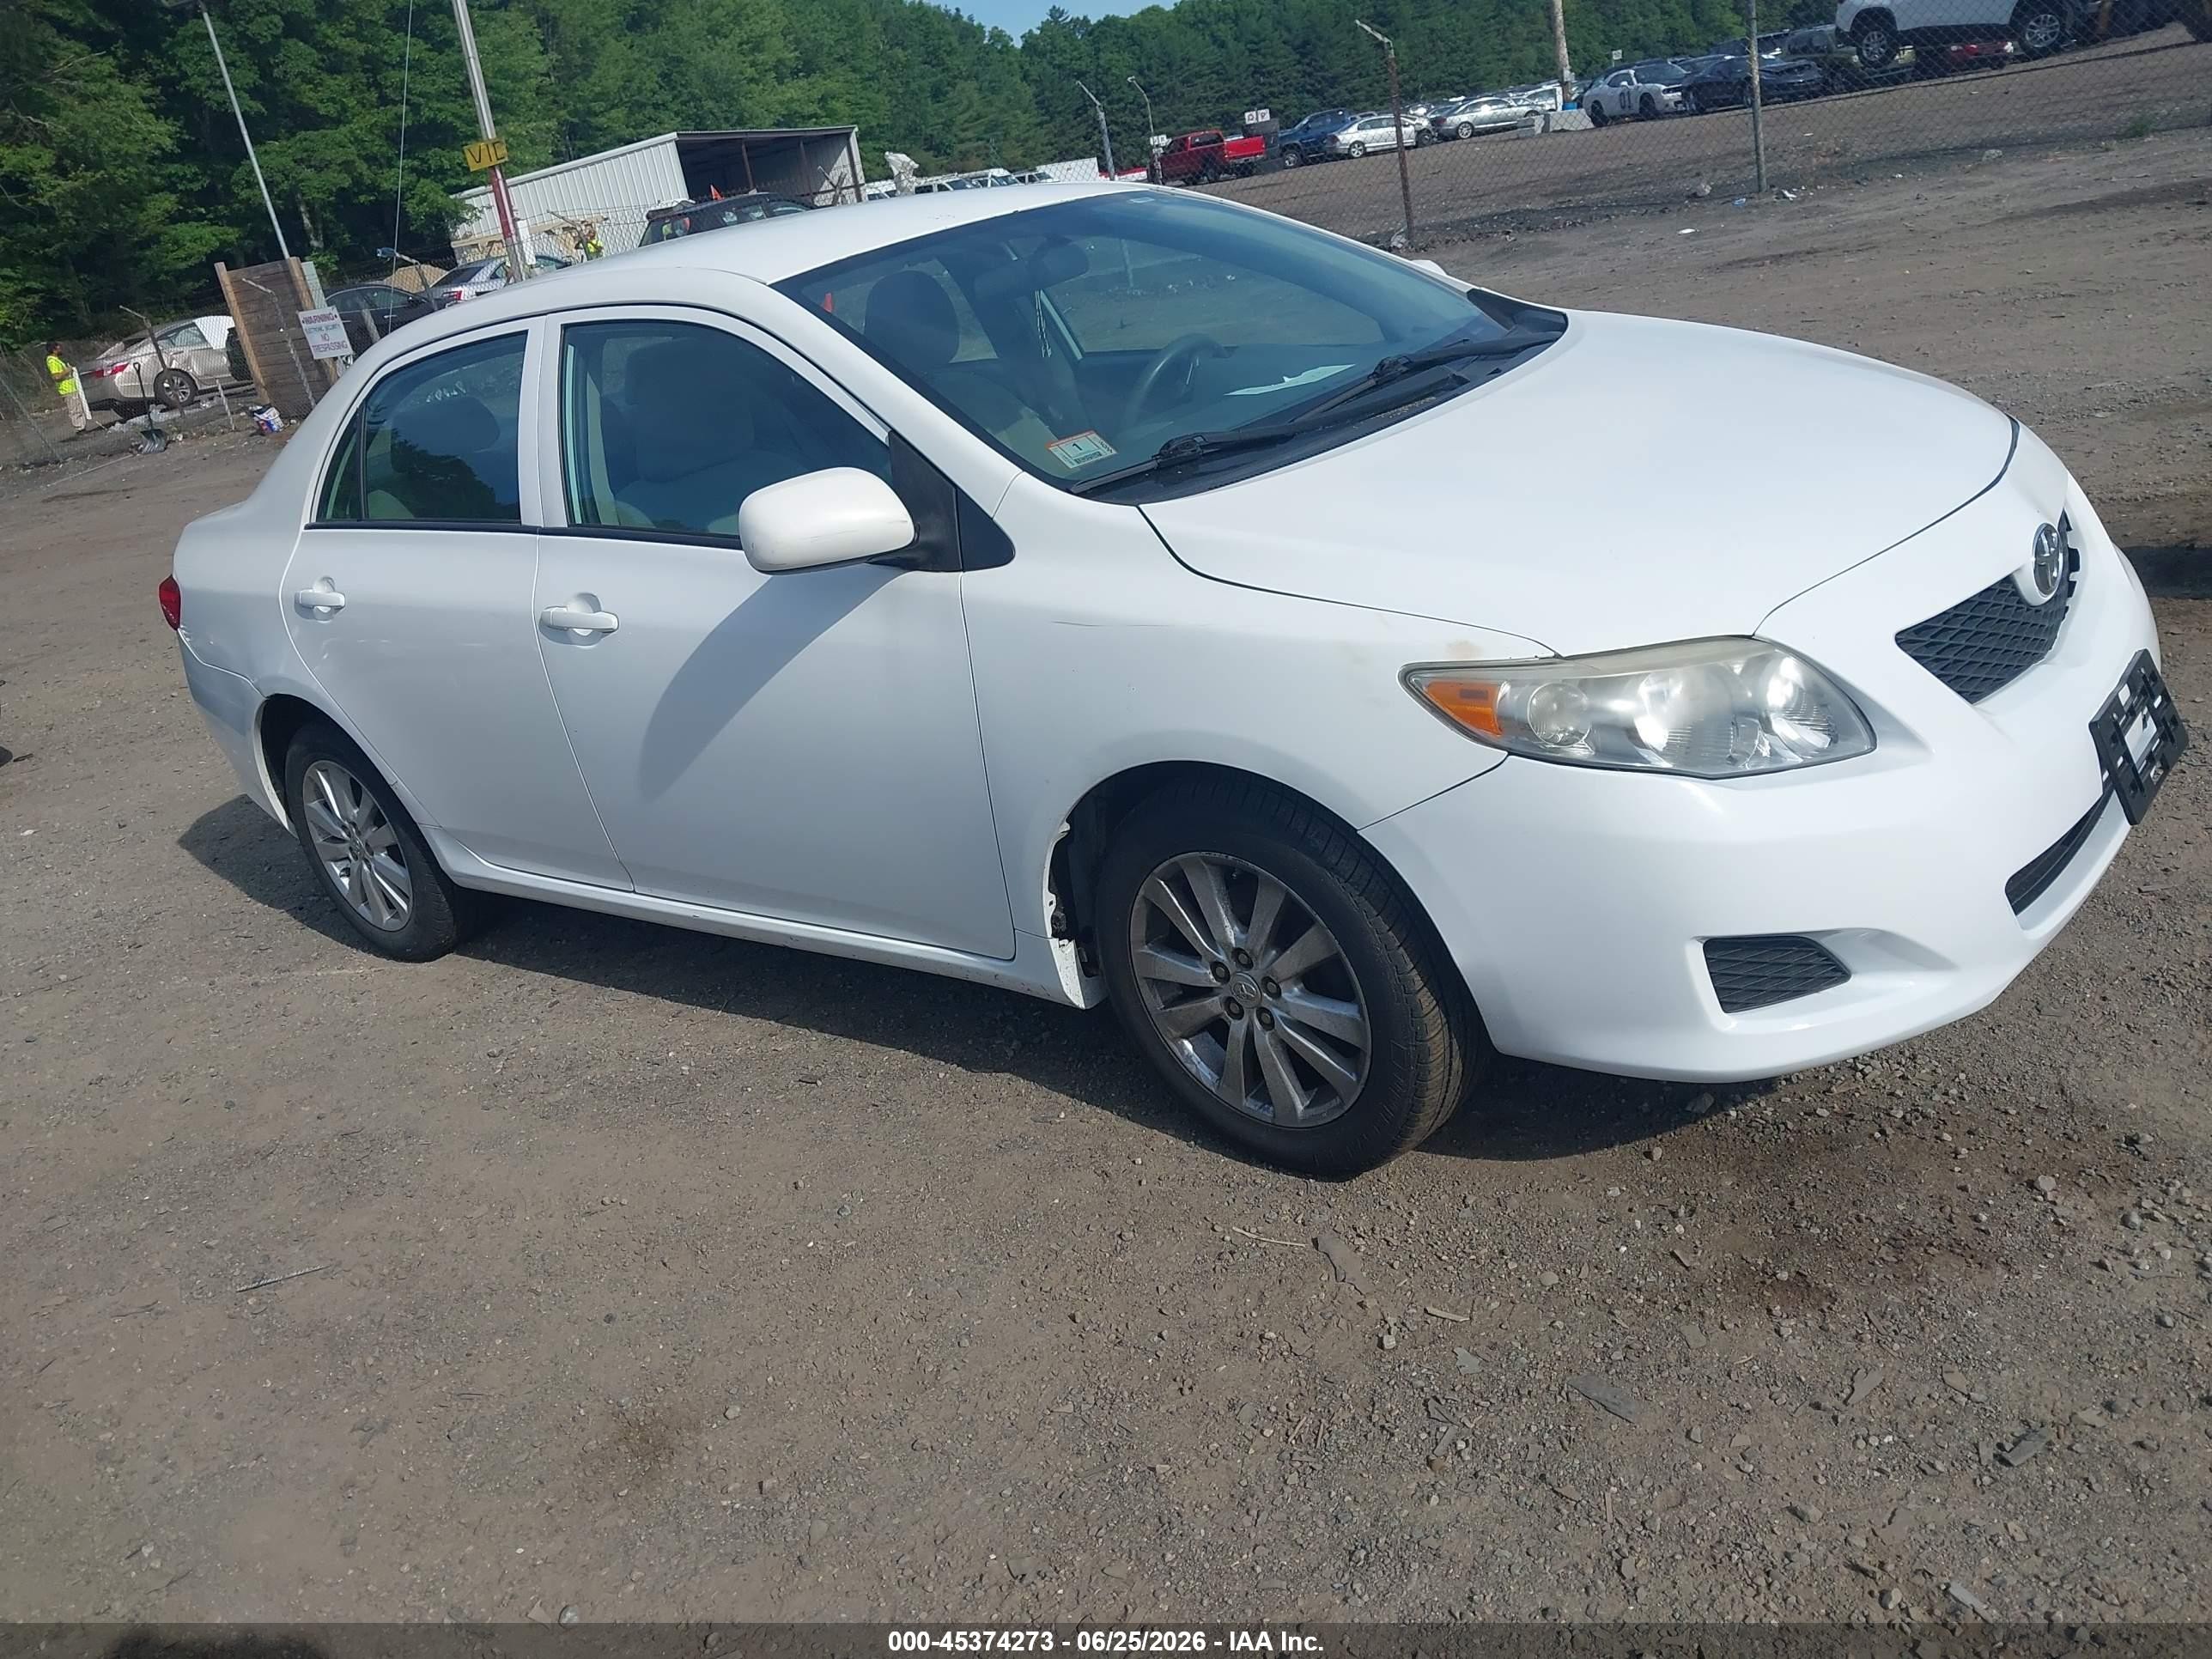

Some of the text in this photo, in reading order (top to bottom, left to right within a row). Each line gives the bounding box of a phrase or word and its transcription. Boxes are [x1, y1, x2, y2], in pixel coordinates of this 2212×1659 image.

[1620, 88, 1632, 110] 01
[303, 313, 335, 325] WARNING
[320, 332, 330, 342] NO
[312, 340, 348, 353] TRESPASSING
